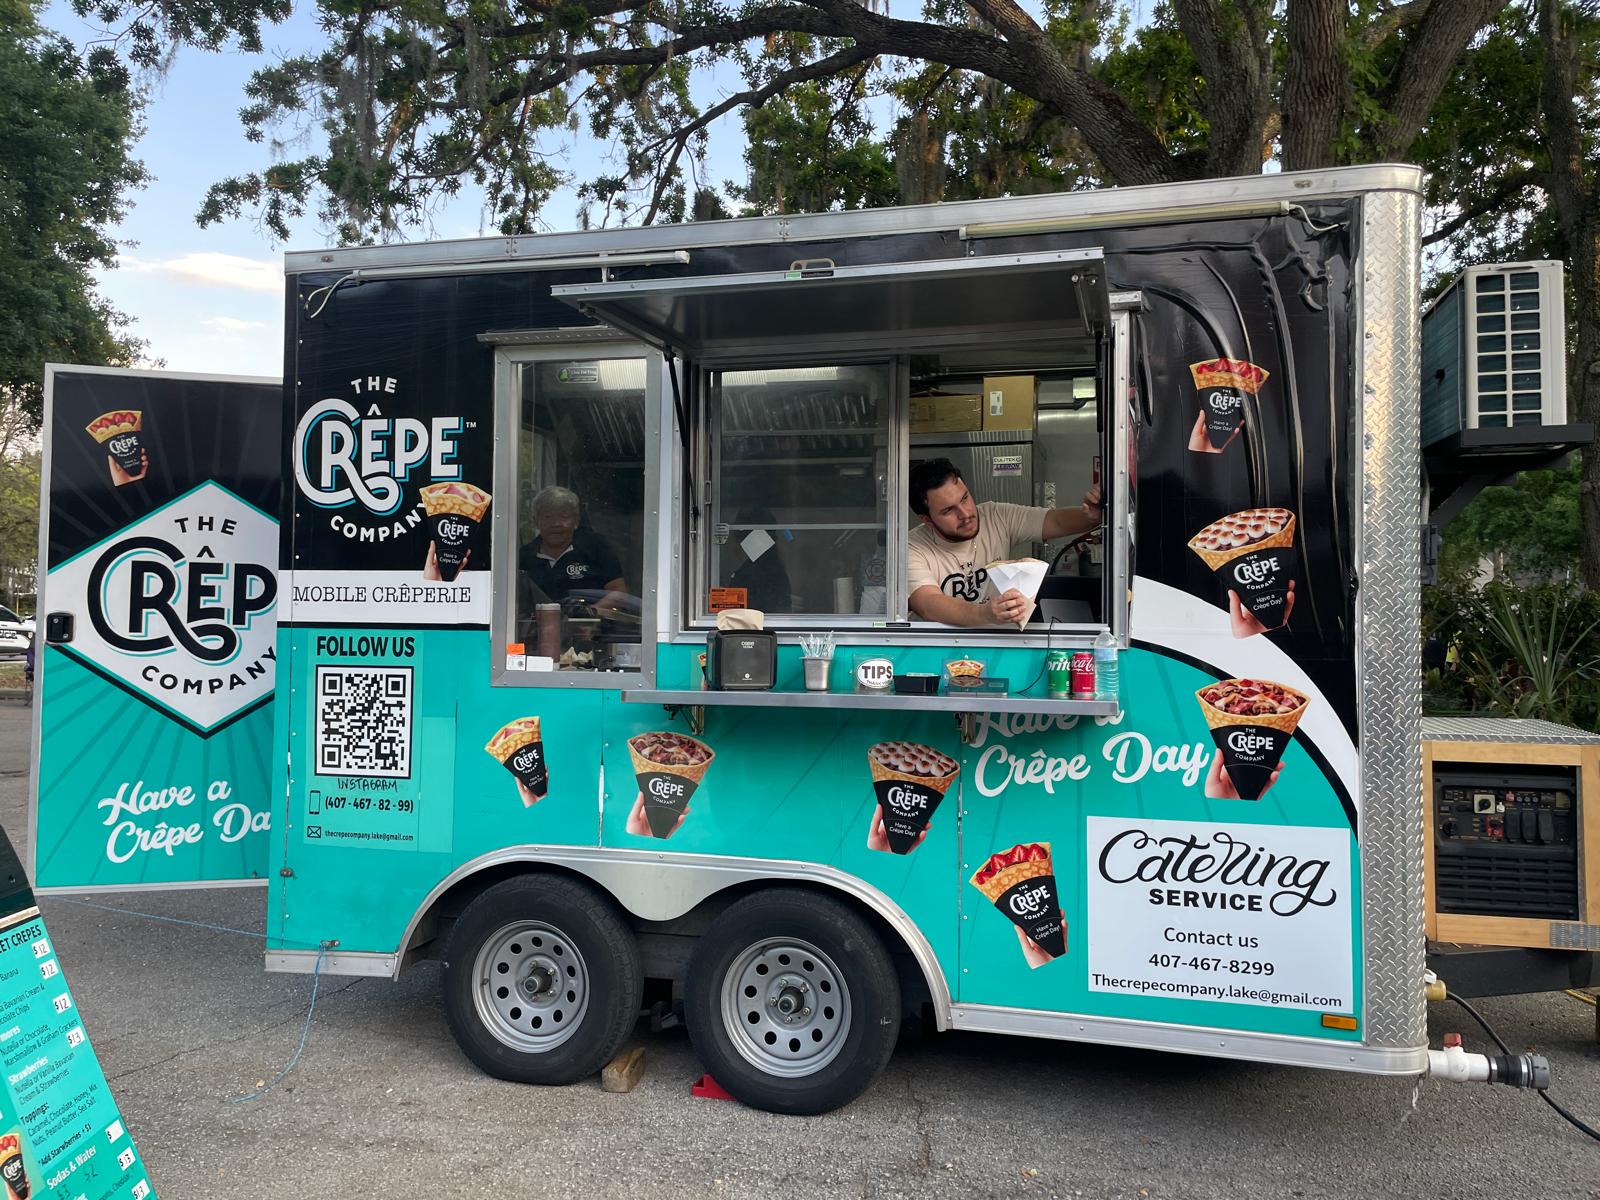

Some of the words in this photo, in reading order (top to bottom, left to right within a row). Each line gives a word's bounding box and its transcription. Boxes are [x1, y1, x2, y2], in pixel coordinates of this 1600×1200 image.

[351, 376, 397, 394] THE
[292, 399, 463, 516] CRÊPE
[174, 516, 237, 536] THE
[438, 519, 470, 540] CRÊPE
[1234, 557, 1280, 584] CRÊPE
[293, 586, 367, 603] MOBILE
[372, 584, 471, 603] CRÊPERIE
[316, 636, 388, 656] FOLLOW
[393, 637, 415, 657] US
[862, 666, 892, 679] TIPS
[1227, 731, 1274, 755] CRÊPE
[975, 744, 1091, 797] Crêpe
[1102, 732, 1210, 786] Day
[1235, 753, 1265, 761] COMPANY
[338, 778, 398, 792] INSTAGRAM
[649, 778, 684, 799] CRÊPE
[98, 780, 195, 826] Have
[208, 780, 232, 801] a
[353, 798, 371, 809] 467
[379, 799, 390, 810] 82
[398, 800, 413, 813] 99)
[888, 786, 928, 810] CRÊPE
[892, 808, 919, 817] COMPANY
[106, 822, 204, 864] Crêpe
[325, 830, 413, 841] thecrepecompany.lake@gmail.com
[1098, 829, 1337, 916] Catering
[1009, 885, 1050, 914] CRÊPE
[1149, 889, 1263, 911] SERVICE
[1024, 904, 1050, 920] COMPANY
[11, 925, 42, 945] CREPES
[1164, 927, 1232, 946] Contact
[1238, 936, 1259, 948] us
[1148, 954, 1275, 976] 407-467-8299
[1092, 974, 1342, 1007] Thecrepecompany.lake@gmail.com
[21, 1103, 50, 1125] Toppings:
[46, 1168, 69, 1190] Sodas
[68, 1161, 76, 1172] &
[75, 1146, 97, 1166] Water
